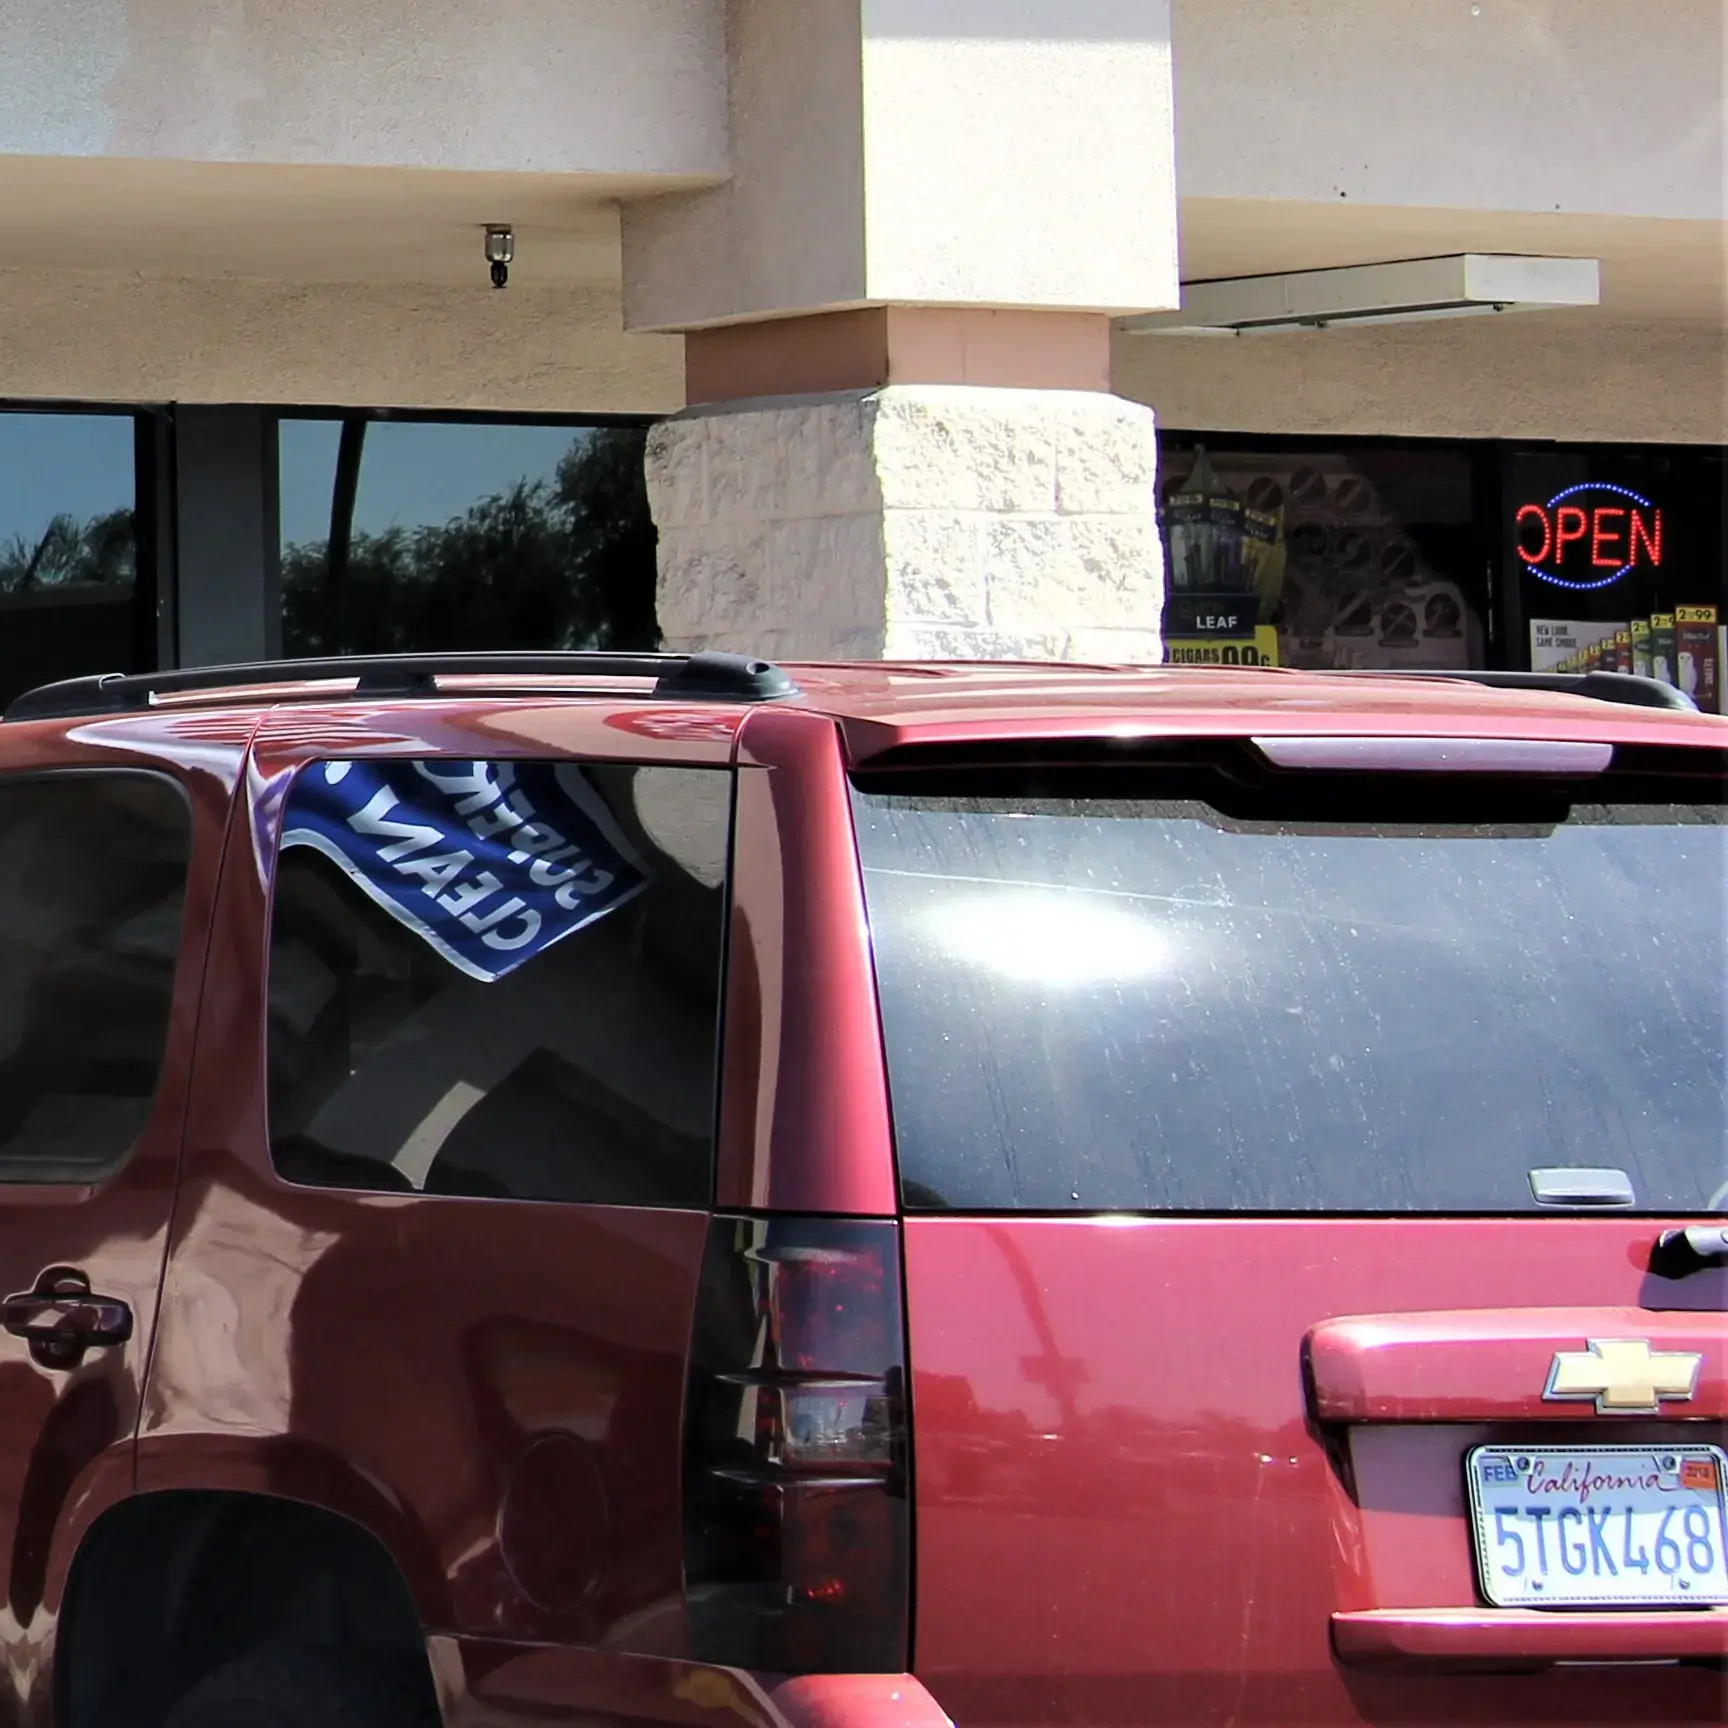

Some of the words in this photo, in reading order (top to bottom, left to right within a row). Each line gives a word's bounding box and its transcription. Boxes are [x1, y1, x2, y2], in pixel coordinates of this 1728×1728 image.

[1516, 503, 1662, 566] OPEN
[1196, 615, 1238, 629] LEAF
[1653, 615, 1661, 626] 2
[1678, 609, 1686, 620] 2
[1172, 648, 1220, 663] CIGARS
[1483, 1464, 1518, 1482] FEB
[1525, 1459, 1677, 1504] California
[1494, 1504, 1715, 1576] 5TGK468
